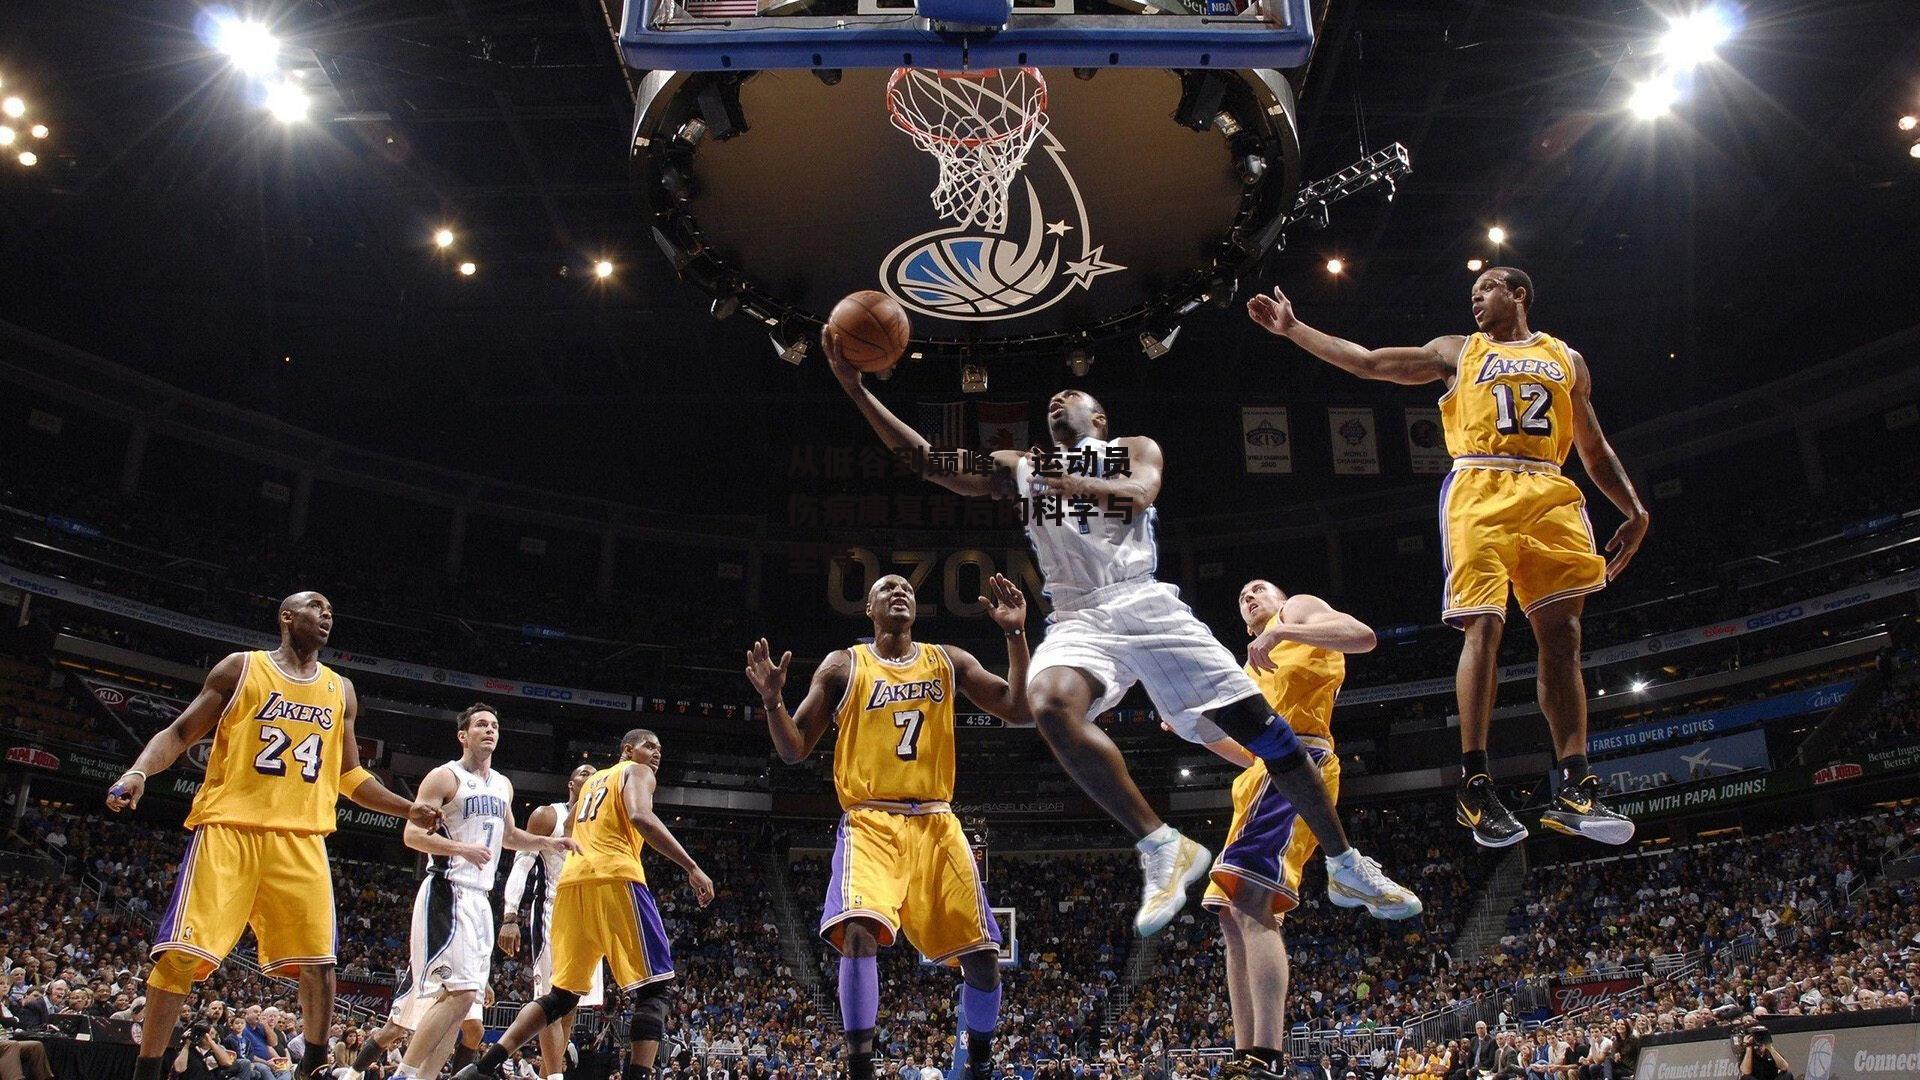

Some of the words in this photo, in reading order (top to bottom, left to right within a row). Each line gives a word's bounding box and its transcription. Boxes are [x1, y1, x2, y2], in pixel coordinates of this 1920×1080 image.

[1475, 352, 1565, 384] LAKERS
[1492, 383, 1552, 436] 12
[9, 576, 58, 595] PEPSICO
[1823, 592, 1871, 610] PEPSICO
[1747, 606, 1803, 629] GEICO
[99, 690, 120, 703] KIA
[522, 684, 572, 700] GEICO
[865, 680, 944, 711] LAKERS
[254, 691, 333, 731] LAKERS
[966, 715, 991, 726] 4:52
[893, 709, 925, 761] 7
[1593, 737, 1622, 752] FARES
[1624, 734, 1636, 746] TO
[1638, 728, 1664, 745] OVER
[1682, 718, 1715, 735] CITIES
[70, 752, 97, 766] Better
[254, 725, 323, 784] 24
[1868, 751, 1895, 762] Better
[1883, 757, 1911, 769] Better
[80, 765, 107, 778] Better
[1611, 771, 1667, 794] Tran
[577, 787, 609, 823] 17
[1618, 801, 1644, 817] WIN
[1648, 794, 1680, 813] WITH
[1684, 787, 1716, 806] PAPA
[1718, 778, 1766, 799] JOHNS!
[336, 809, 353, 823] PA
[355, 812, 400, 831] JOHNS!
[483, 822, 495, 848] 7
[1657, 1061, 1699, 1080] Connect
[1699, 1061, 1712, 1077] at
[1854, 1049, 1920, 1073] Connec
